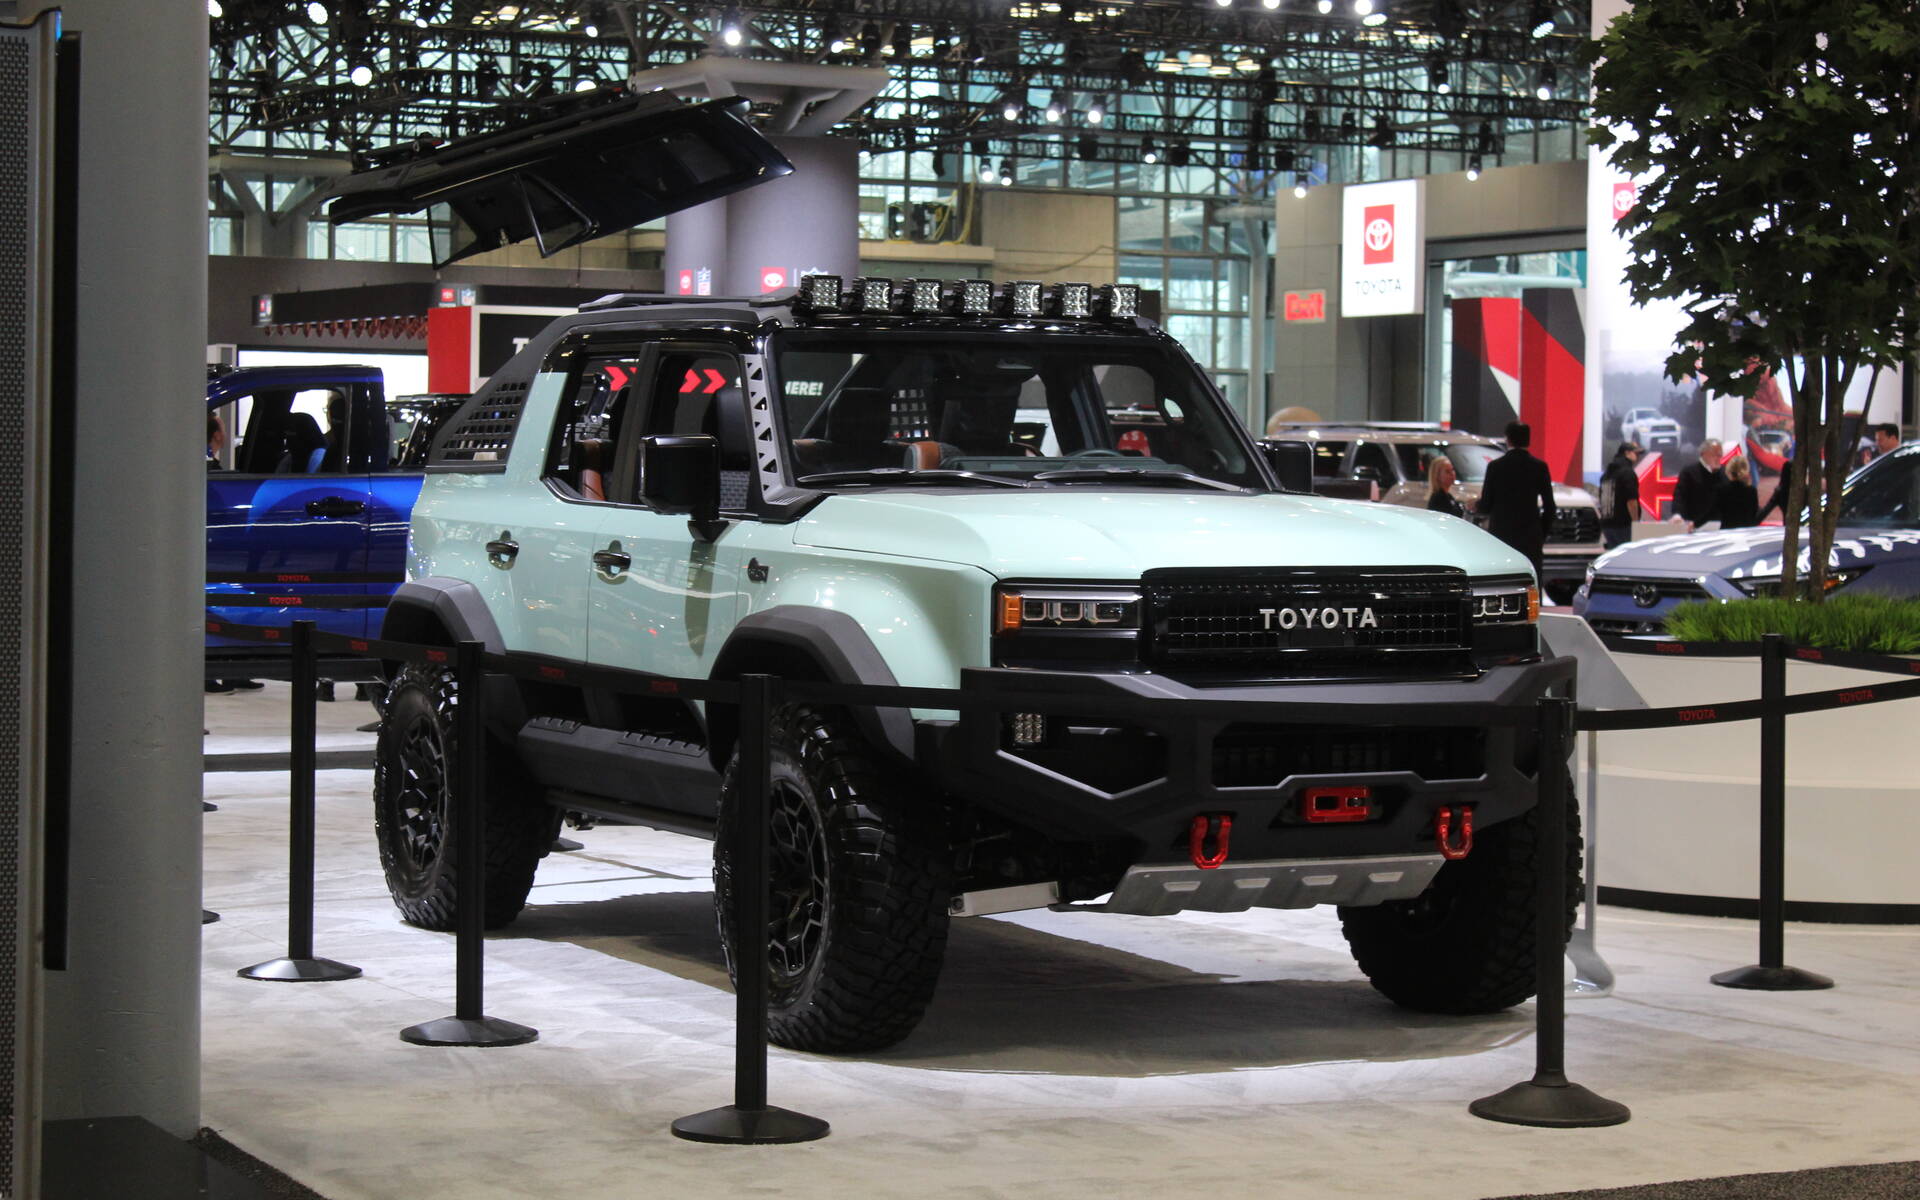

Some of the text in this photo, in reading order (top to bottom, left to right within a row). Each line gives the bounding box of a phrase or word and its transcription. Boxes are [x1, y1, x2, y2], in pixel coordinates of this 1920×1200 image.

[1354, 278, 1401, 296] TOYOTA
[268, 596, 303, 605] TOYOTA
[1259, 607, 1378, 630] TOYOTA
[1837, 689, 1873, 704] TOYOTA
[1678, 709, 1717, 721] TOYOTA
